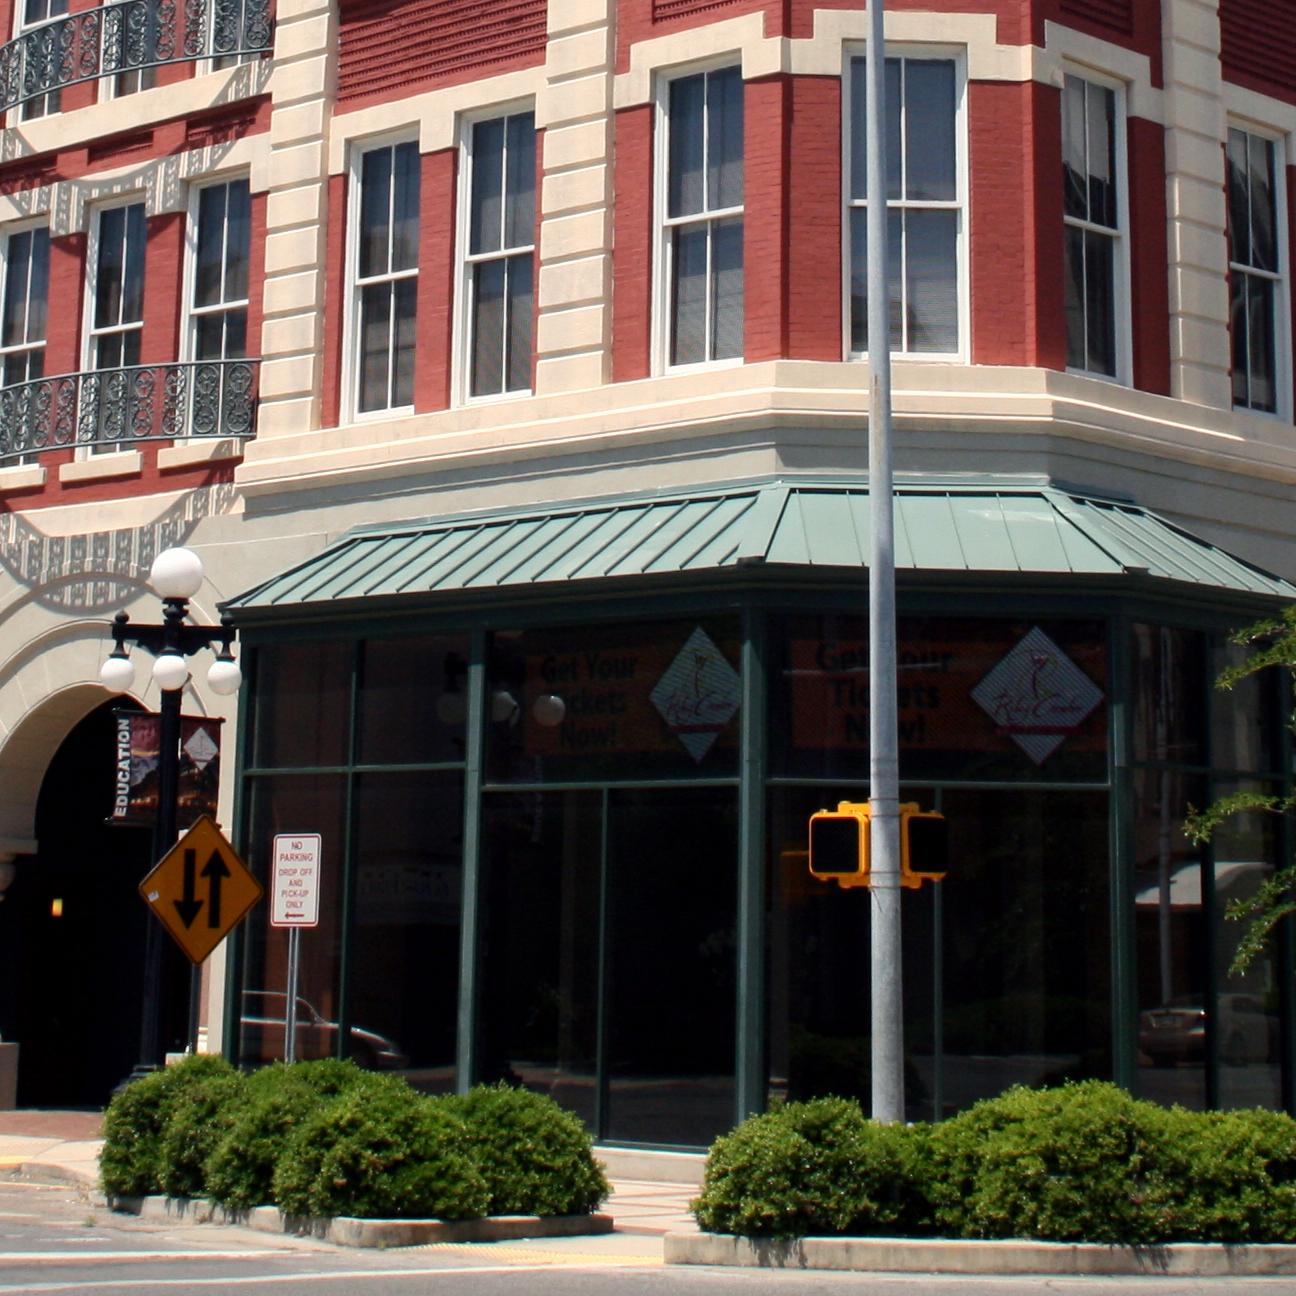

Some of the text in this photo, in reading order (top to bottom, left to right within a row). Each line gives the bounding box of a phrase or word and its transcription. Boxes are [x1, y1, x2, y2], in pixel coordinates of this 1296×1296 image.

[114, 719, 130, 816] EDUCATION
[291, 841, 303, 850] NO
[280, 853, 313, 862] PARKING
[279, 868, 312, 876] DROP OFF
[288, 879, 303, 887] AND
[281, 889, 309, 898] PICK-UP
[286, 900, 303, 908] ONLY
